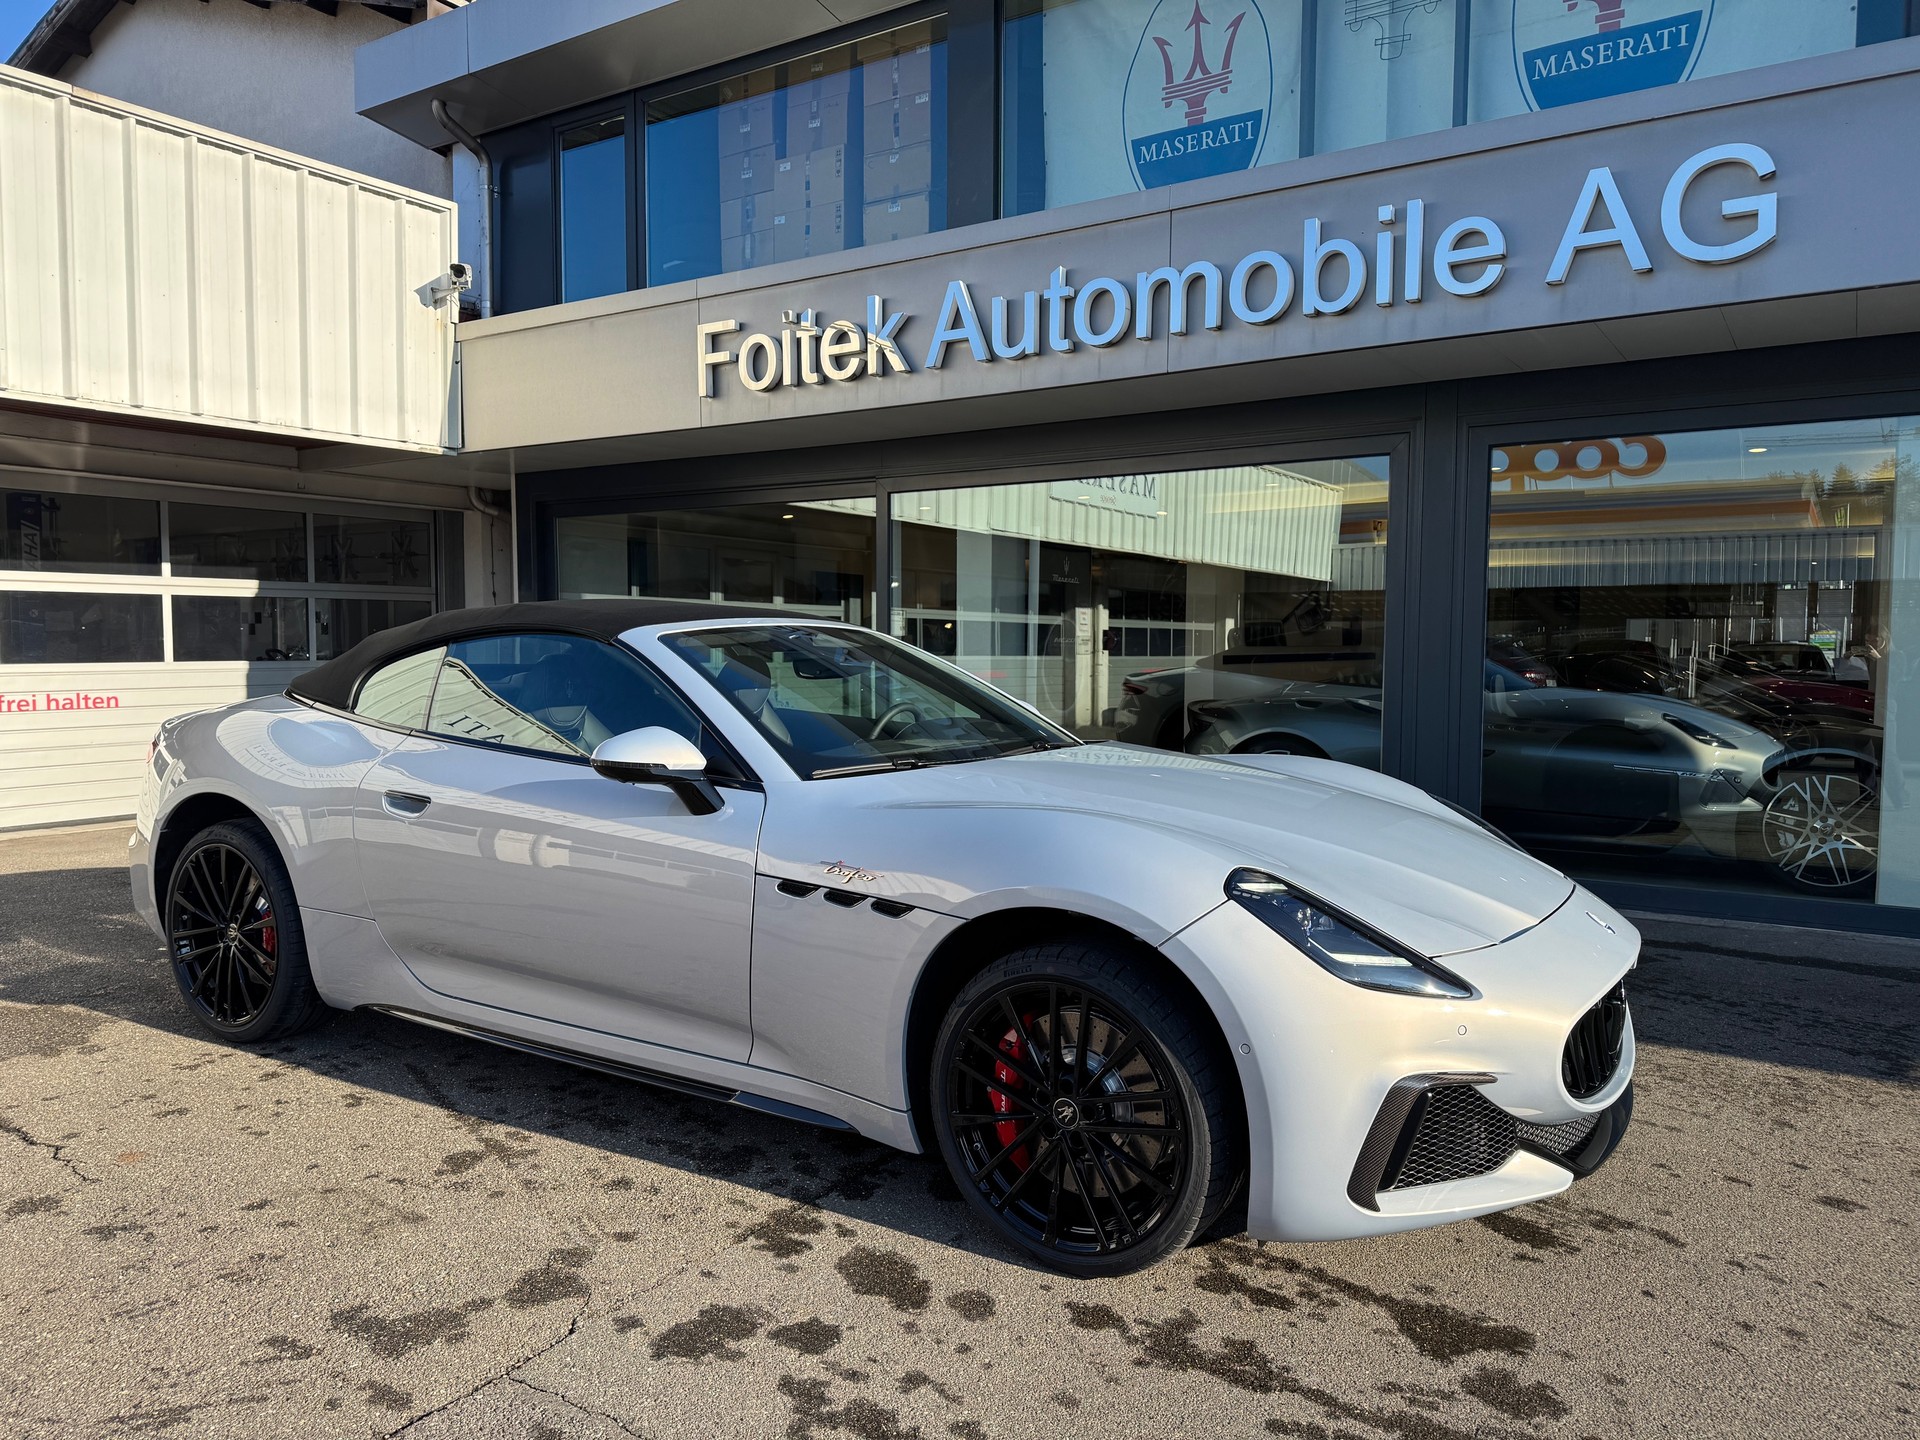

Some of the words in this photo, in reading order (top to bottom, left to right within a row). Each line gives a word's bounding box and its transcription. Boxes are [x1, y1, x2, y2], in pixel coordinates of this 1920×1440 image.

[1532, 23, 1690, 80] MASERATI
[1138, 120, 1255, 164] MASERATI
[697, 294, 912, 400] Foitek
[925, 198, 1507, 370] Automobile
[1544, 142, 1778, 286] AG
[0, 693, 37, 713] frei
[46, 692, 120, 711] halten
